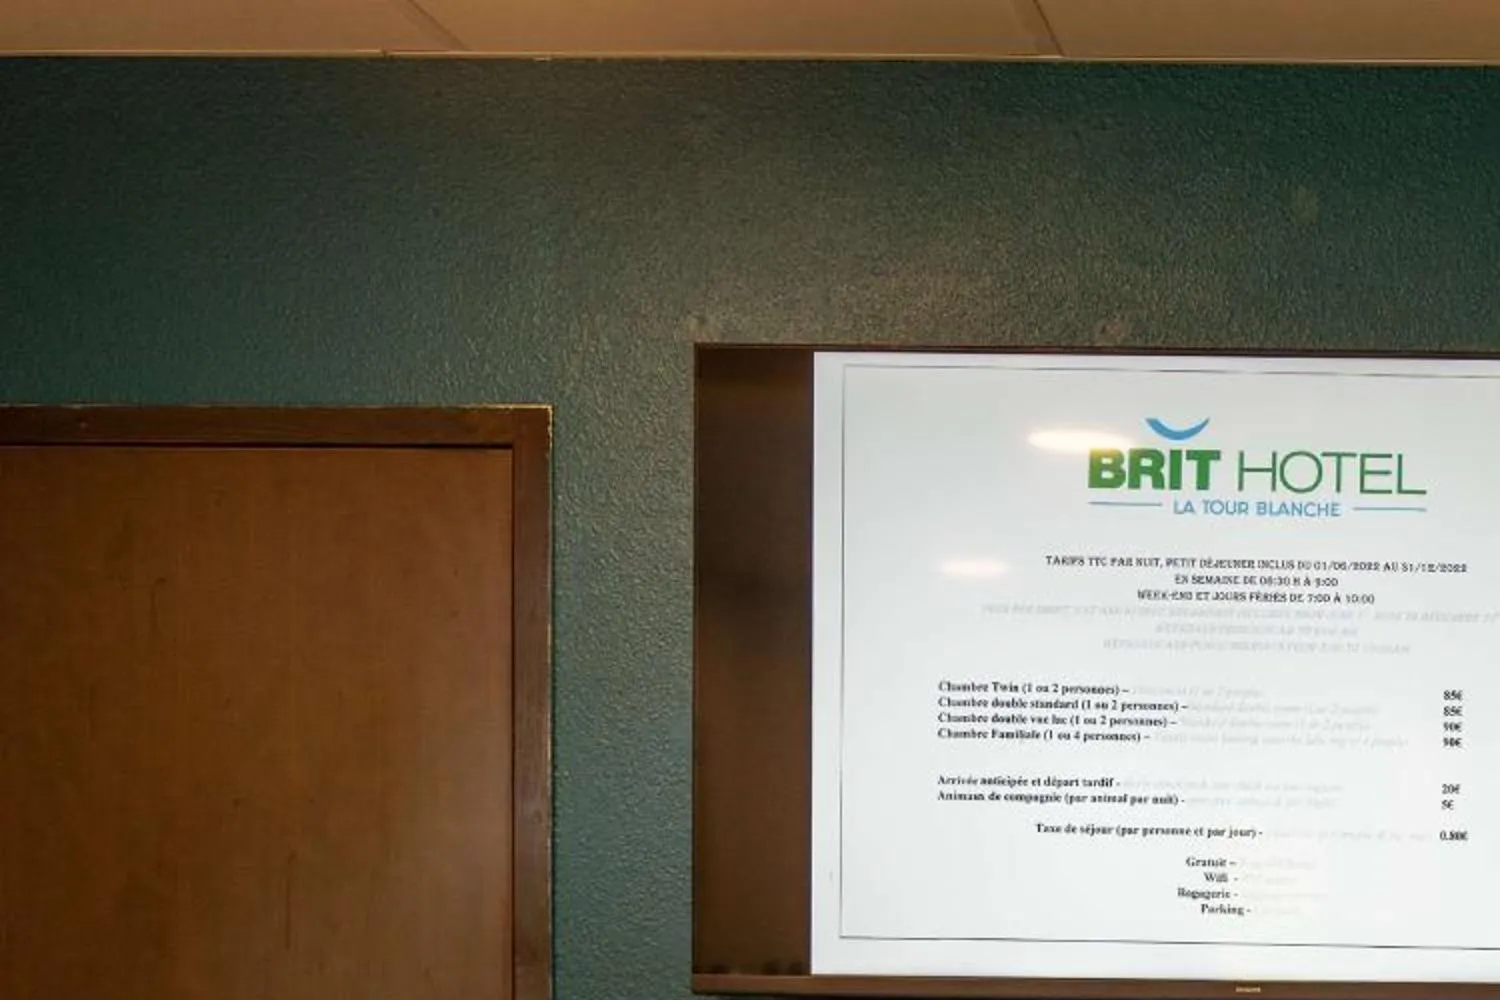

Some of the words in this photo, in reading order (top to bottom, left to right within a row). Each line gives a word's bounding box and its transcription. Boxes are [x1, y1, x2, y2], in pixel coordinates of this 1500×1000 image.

[1088, 448, 1222, 491] BRIT
[1238, 450, 1427, 495] HOTEL
[1202, 499, 1249, 517] TOUR
[1256, 501, 1341, 518] BLANCHE
[1045, 555, 1085, 566] TARIFS
[1088, 556, 1107, 567] TTC
[1110, 557, 1133, 567] PAR
[1165, 558, 1197, 568] PETIT
[1257, 560, 1295, 570] INCLUS
[1191, 573, 1241, 585] SEMAINE
[1137, 589, 1193, 600] WEEK-END
[1212, 591, 1247, 602] JOURS
[1307, 593, 1331, 604] 7:00
[1345, 594, 1375, 605] 10:00
[938, 680, 989, 692] Chambre
[991, 681, 1019, 693] Twin
[1061, 684, 1120, 697] personnes)
[1442, 689, 1464, 701] 85€
[937, 696, 989, 708] Chambre
[991, 697, 1028, 709] double
[1029, 698, 1079, 710] standard
[1120, 701, 1180, 714] personnes)
[1442, 706, 1464, 717] 85€
[937, 711, 989, 723] Chambre
[991, 713, 1028, 725] double
[1109, 716, 1168, 728] personnes)
[937, 728, 989, 739] Chambre
[1083, 732, 1142, 743] personnes)
[936, 775, 978, 786] Arrivée
[979, 776, 1028, 789] anticipée
[1043, 776, 1079, 789] départ
[1081, 777, 1114, 788] tardif
[1441, 784, 1462, 795] 20€
[1003, 792, 1062, 805] compagnie
[1064, 793, 1088, 805] (par
[1090, 793, 1128, 803] animal
[1130, 796, 1150, 806] par
[1035, 822, 1062, 833] Taxe
[1079, 824, 1113, 837] séjour
[1116, 825, 1140, 837] (par
[1141, 827, 1192, 838] personne
[1206, 828, 1227, 839] par
[1200, 904, 1245, 916] Parking
